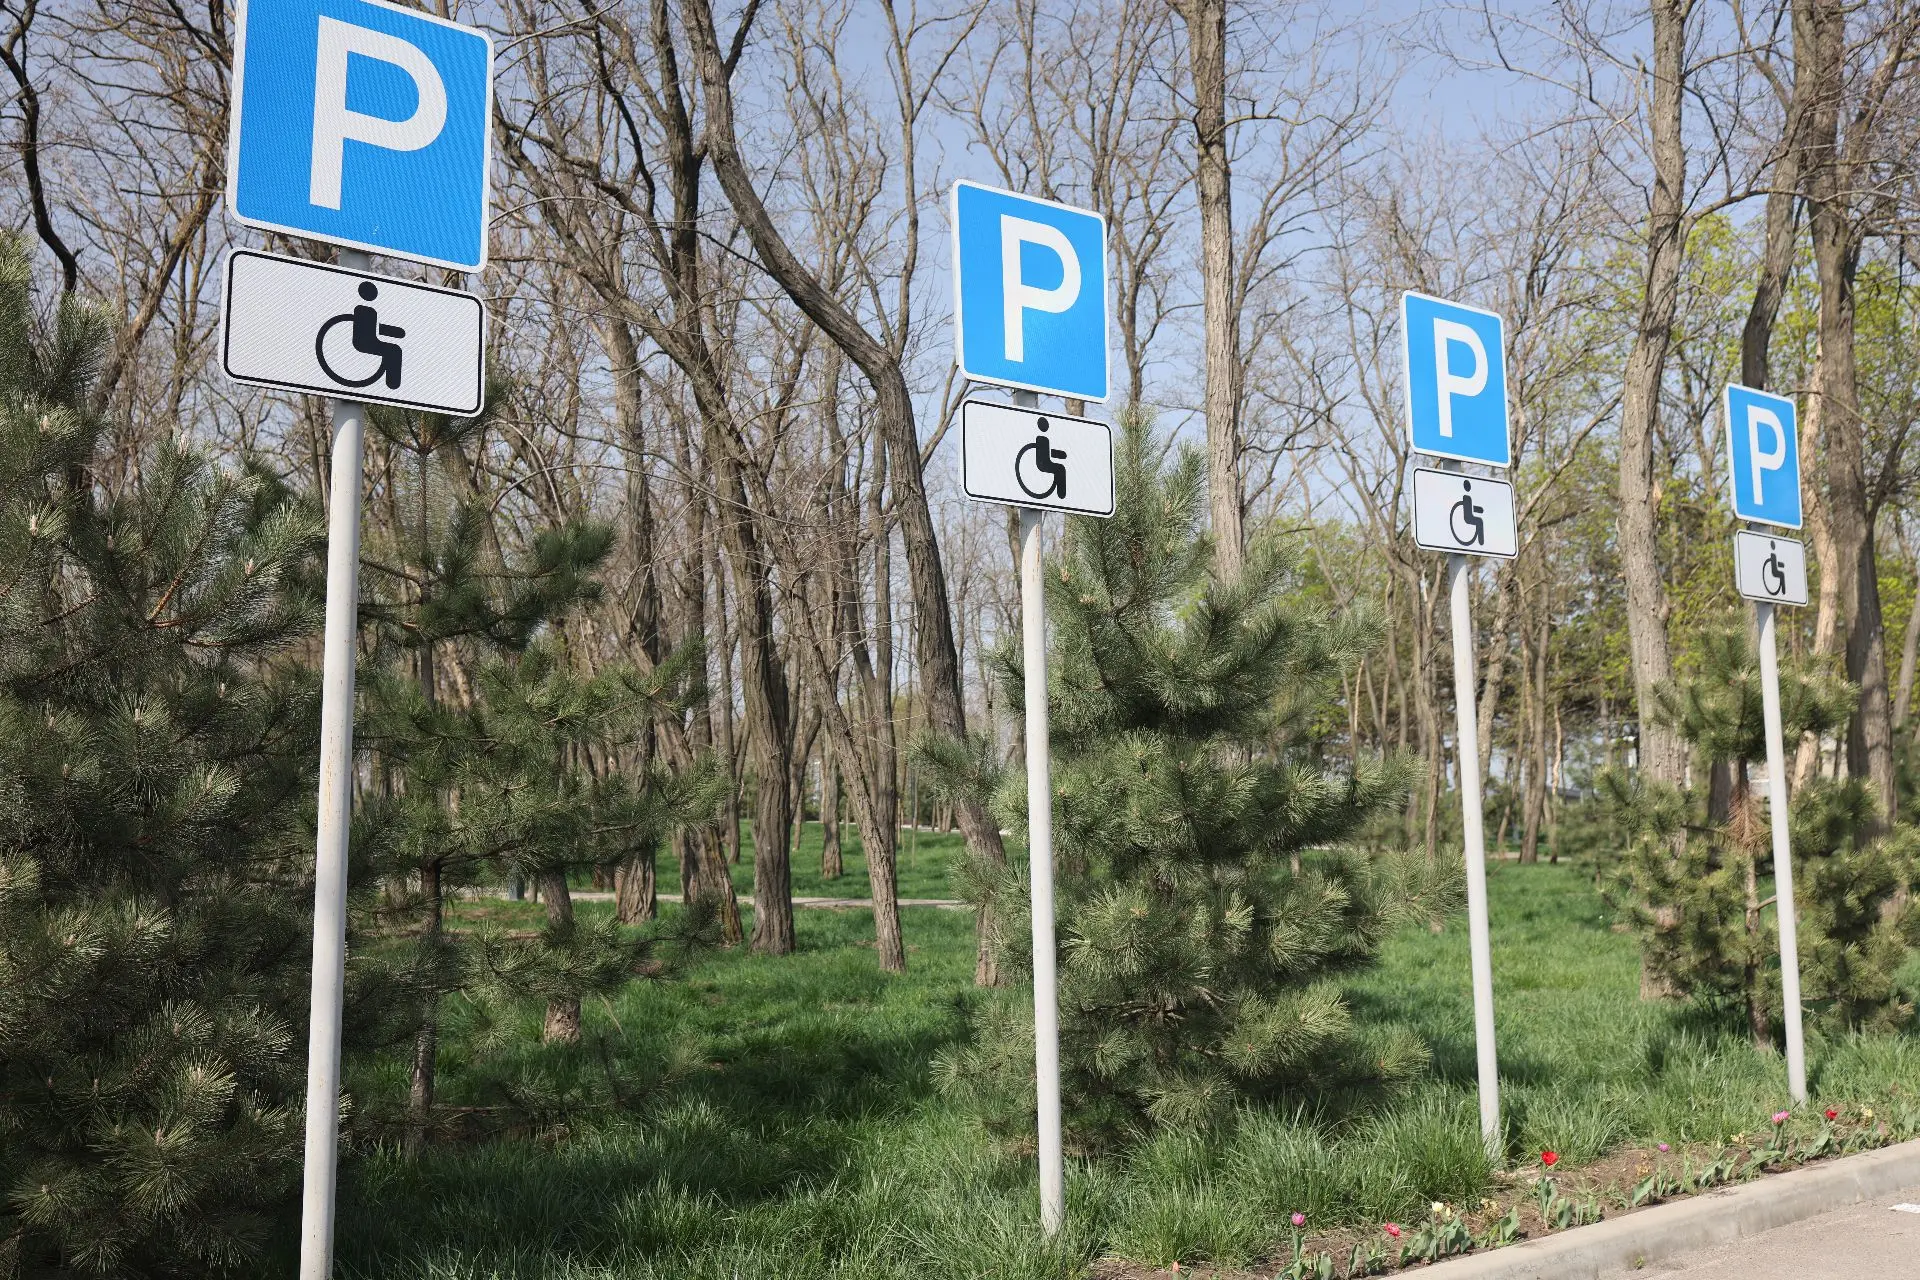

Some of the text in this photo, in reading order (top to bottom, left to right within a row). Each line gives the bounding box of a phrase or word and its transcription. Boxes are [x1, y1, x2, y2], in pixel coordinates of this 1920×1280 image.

[310, 15, 448, 211] P
[1000, 213, 1082, 363] P
[1433, 318, 1488, 437] P
[1747, 404, 1786, 505] P
